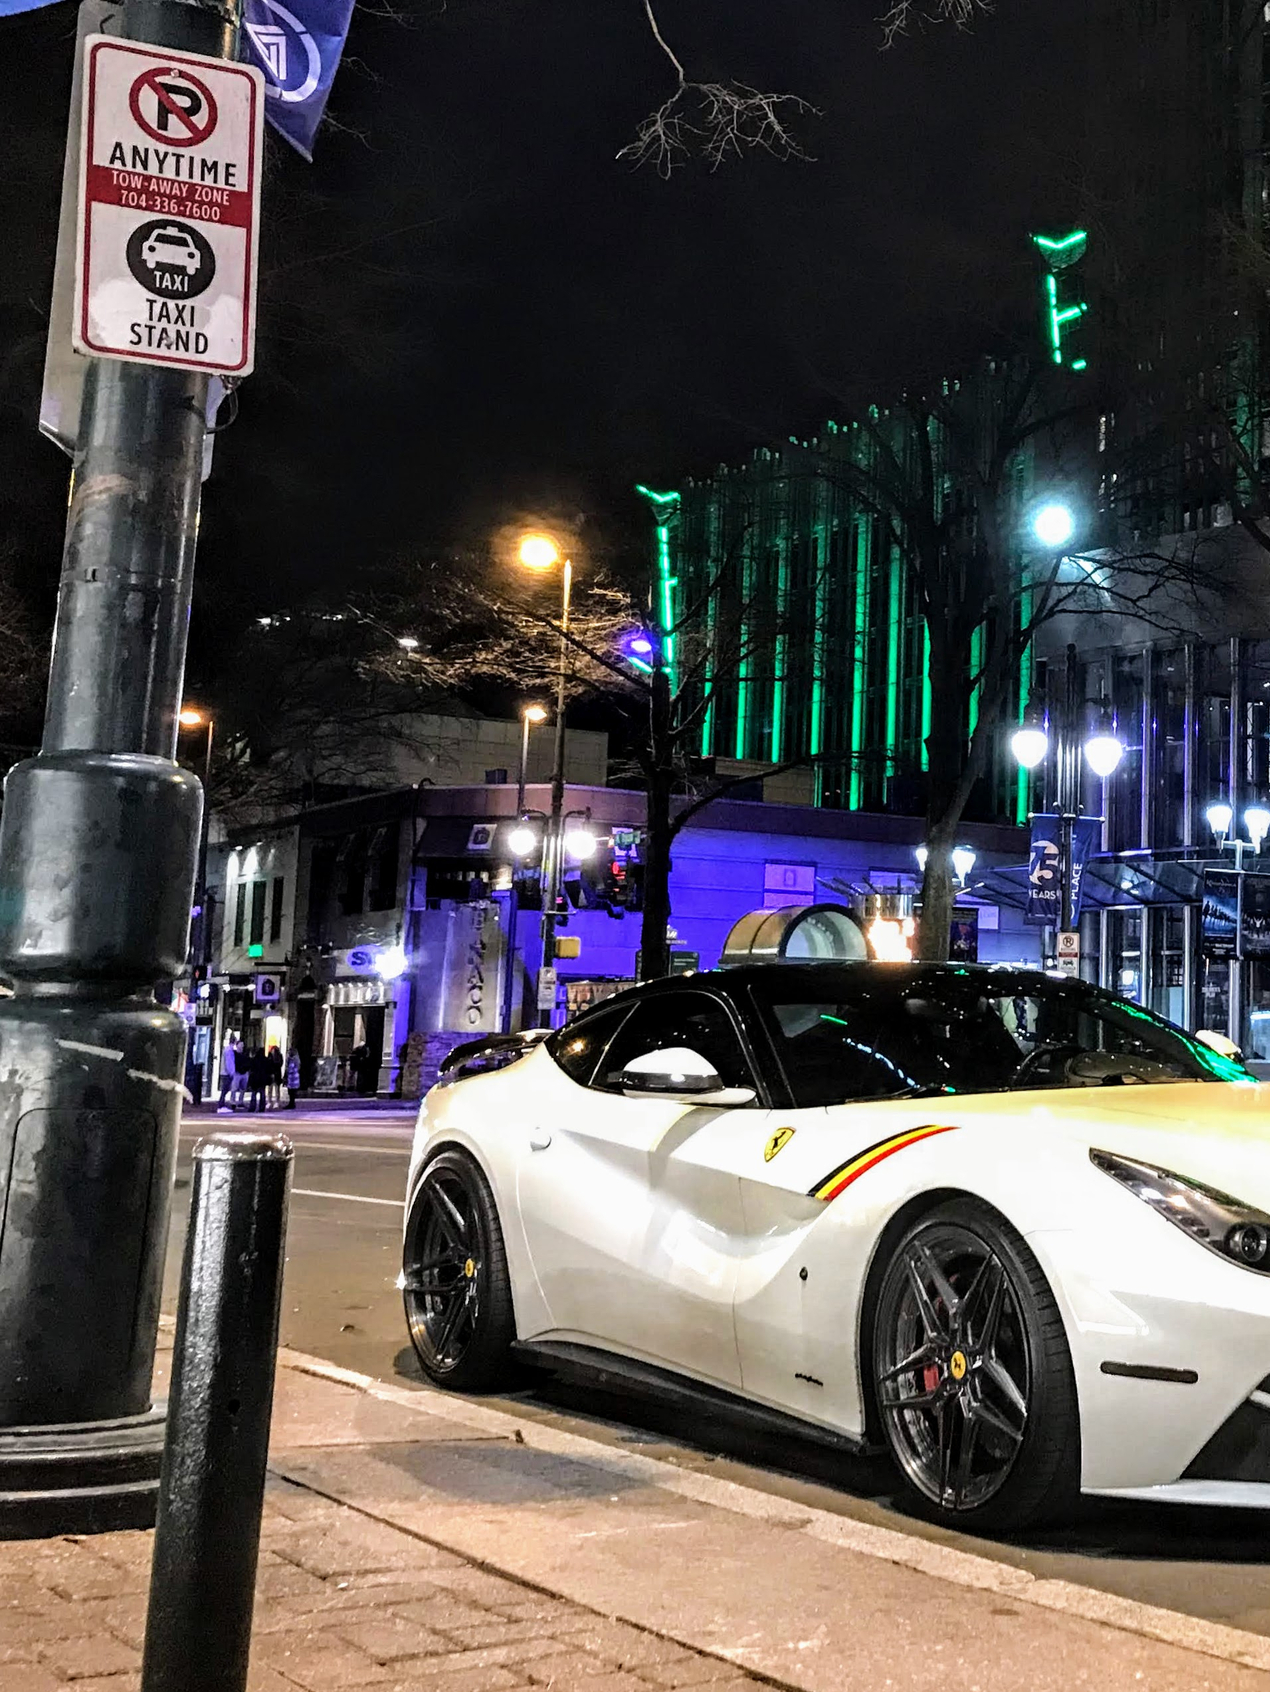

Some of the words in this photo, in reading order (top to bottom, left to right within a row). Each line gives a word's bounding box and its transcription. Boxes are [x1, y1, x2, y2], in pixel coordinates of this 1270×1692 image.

[109, 141, 238, 187] ANYTIME
[112, 170, 189, 197] TOW-AWAY
[194, 183, 230, 205] ZONE
[121, 190, 221, 221] 704-336-7600
[154, 271, 189, 292] TAXI
[146, 298, 195, 328] TAXI
[129, 322, 209, 354] STAND
[1070, 862, 1083, 900] PLACE
